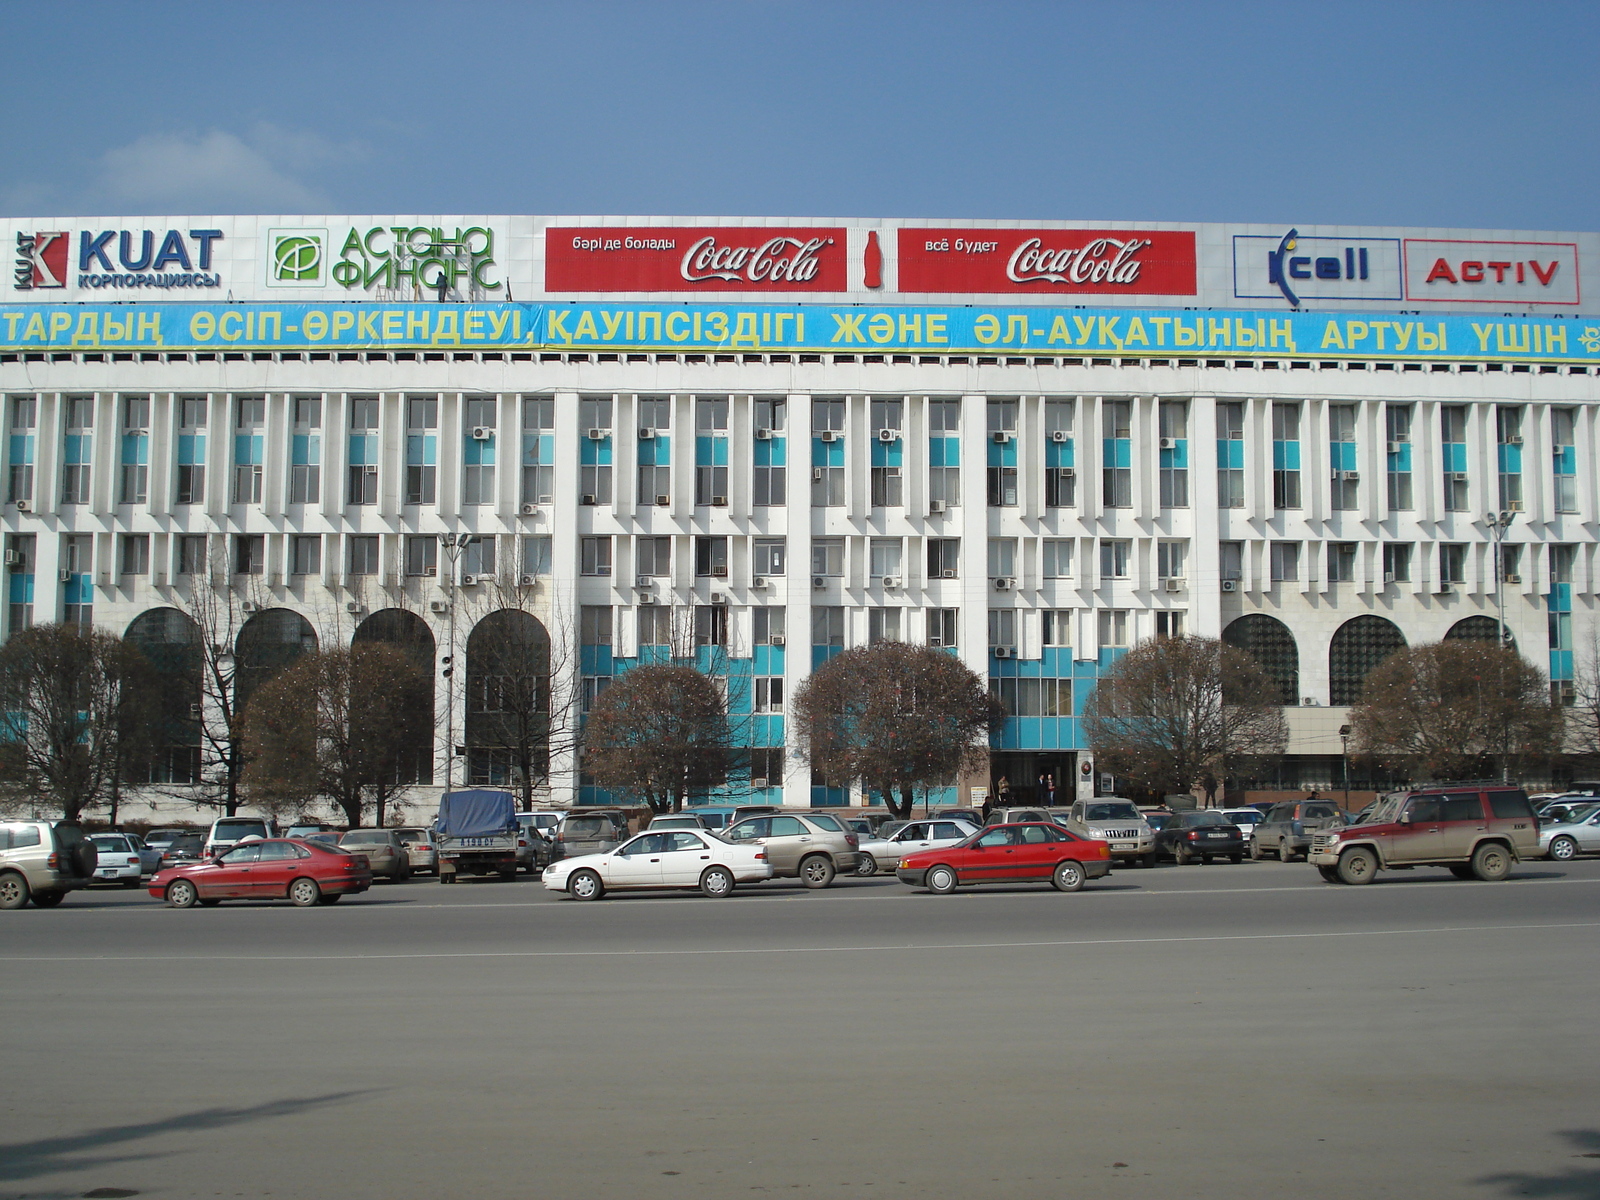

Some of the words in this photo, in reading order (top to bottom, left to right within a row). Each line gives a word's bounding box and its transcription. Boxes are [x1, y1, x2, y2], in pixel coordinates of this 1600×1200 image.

[14, 231, 35, 289] KUAT
[79, 230, 223, 271] KUAT
[572, 237, 602, 251] бәрі
[604, 239, 621, 250] де
[624, 237, 675, 250] болады
[680, 236, 833, 282] Coca-Cola
[925, 238, 949, 251] всё
[954, 238, 998, 252] будет
[1006, 238, 1150, 284] Coca-Cola
[78, 273, 220, 288] КОРПОРАЦИЯСЫ
[831, 314, 948, 343] ЖӘНЕ
[1321, 320, 1447, 351] АРТУЫ
